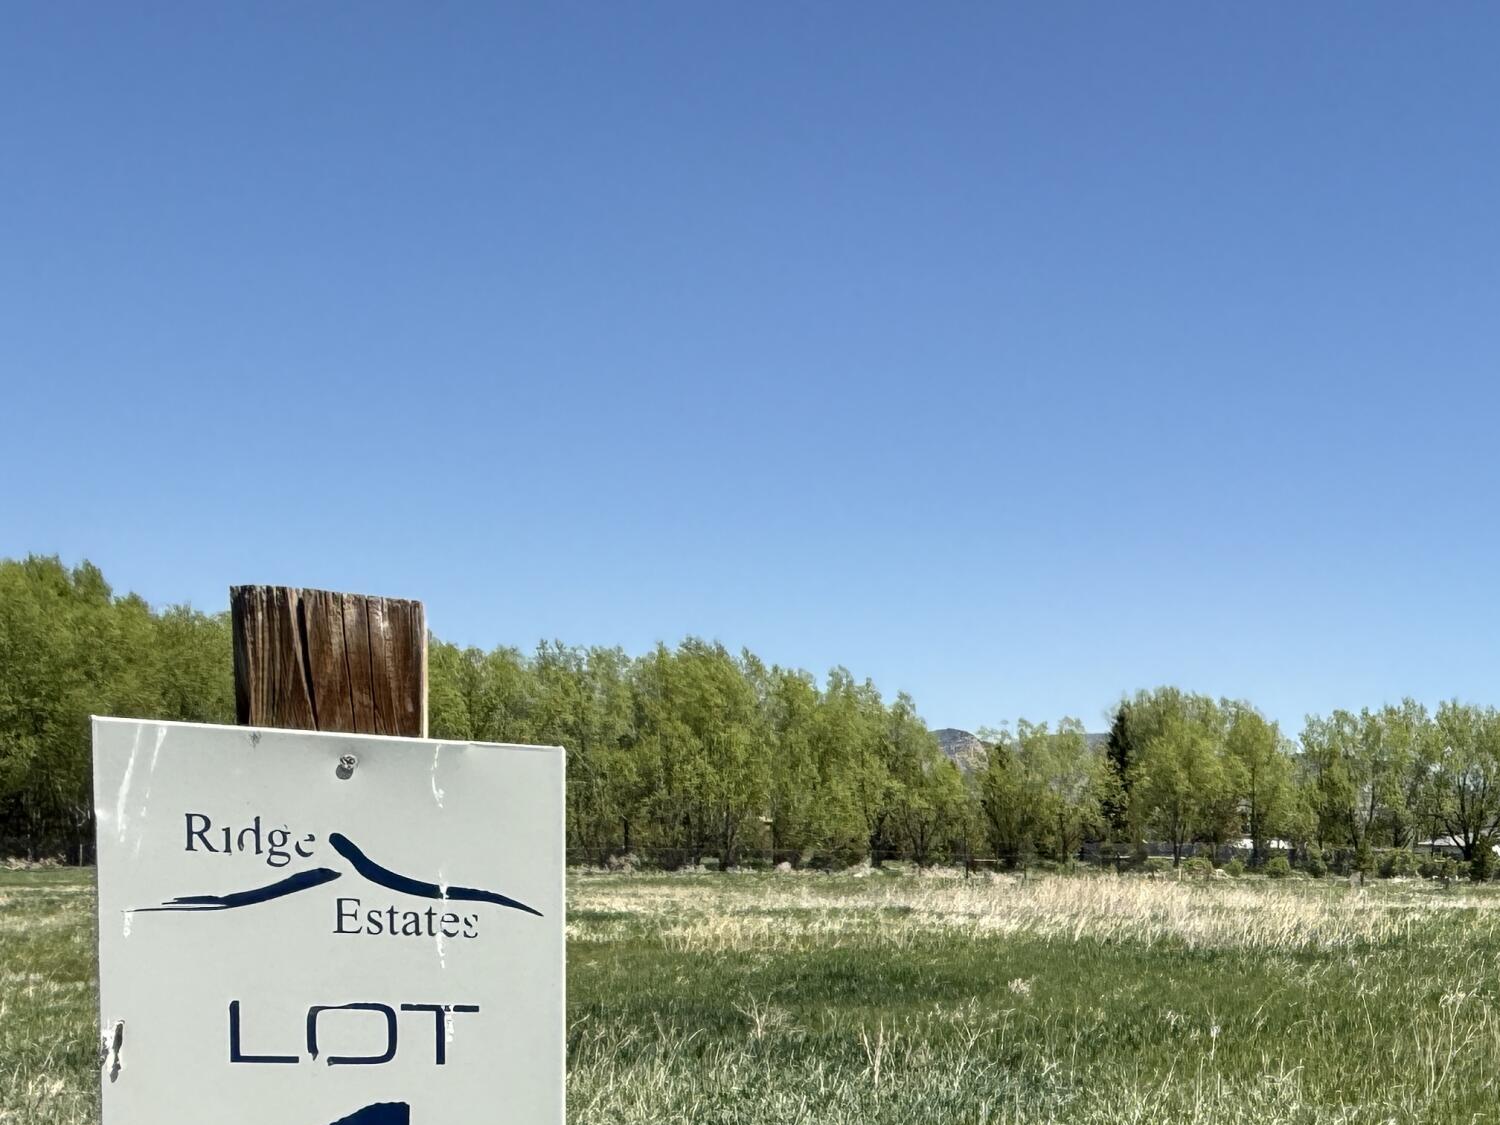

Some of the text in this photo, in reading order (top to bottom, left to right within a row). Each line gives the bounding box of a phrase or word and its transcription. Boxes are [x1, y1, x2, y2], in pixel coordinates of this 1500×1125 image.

[184, 812, 316, 867] Ridge
[333, 897, 480, 939] Estates
[229, 1000, 480, 1065] LOT
